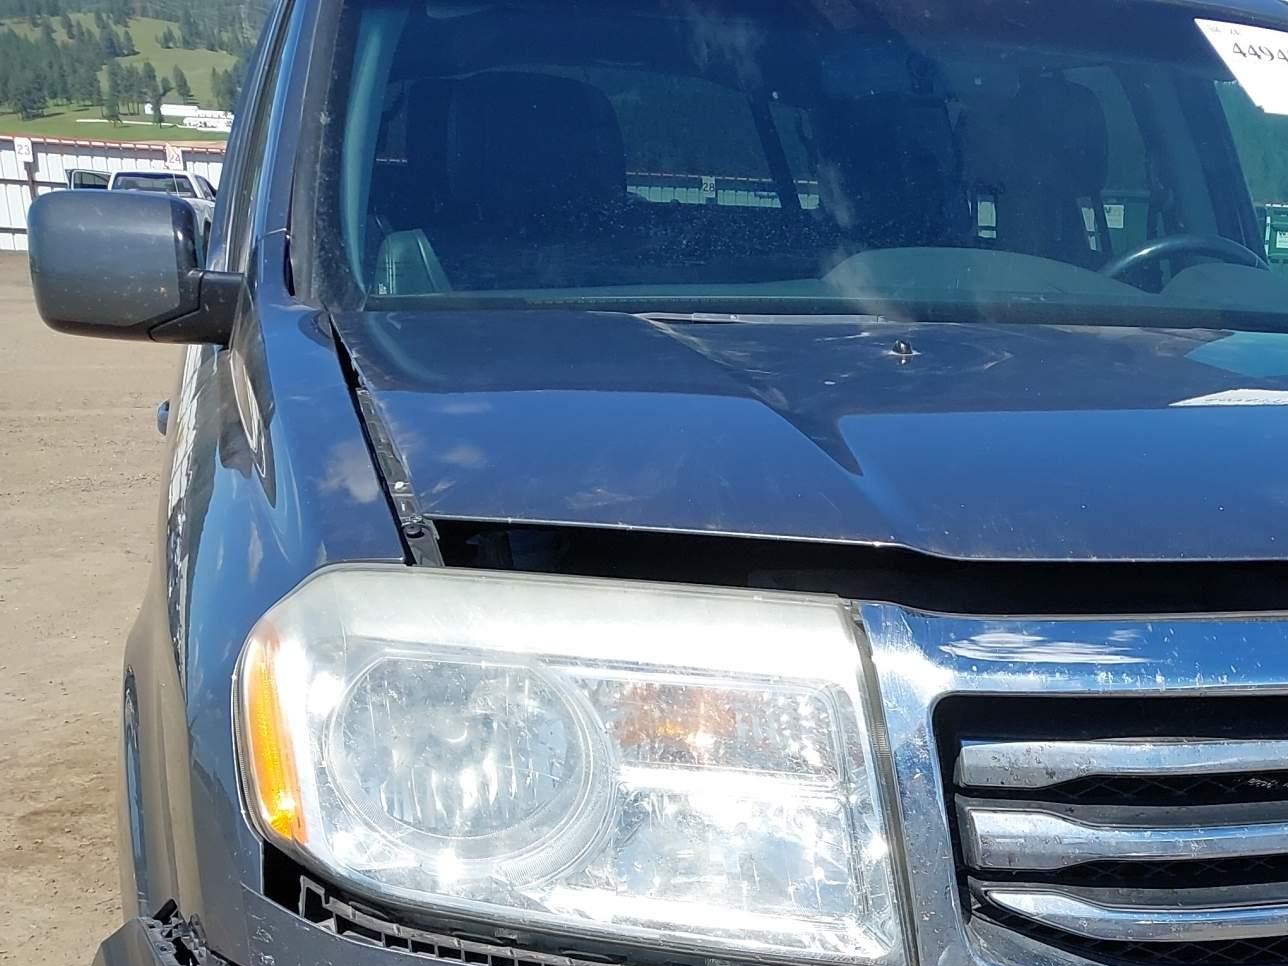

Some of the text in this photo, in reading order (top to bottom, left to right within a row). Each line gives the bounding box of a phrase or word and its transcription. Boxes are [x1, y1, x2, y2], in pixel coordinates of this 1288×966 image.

[17, 143, 31, 156] 23
[168, 151, 182, 165] 24
[702, 182, 715, 193] 28
